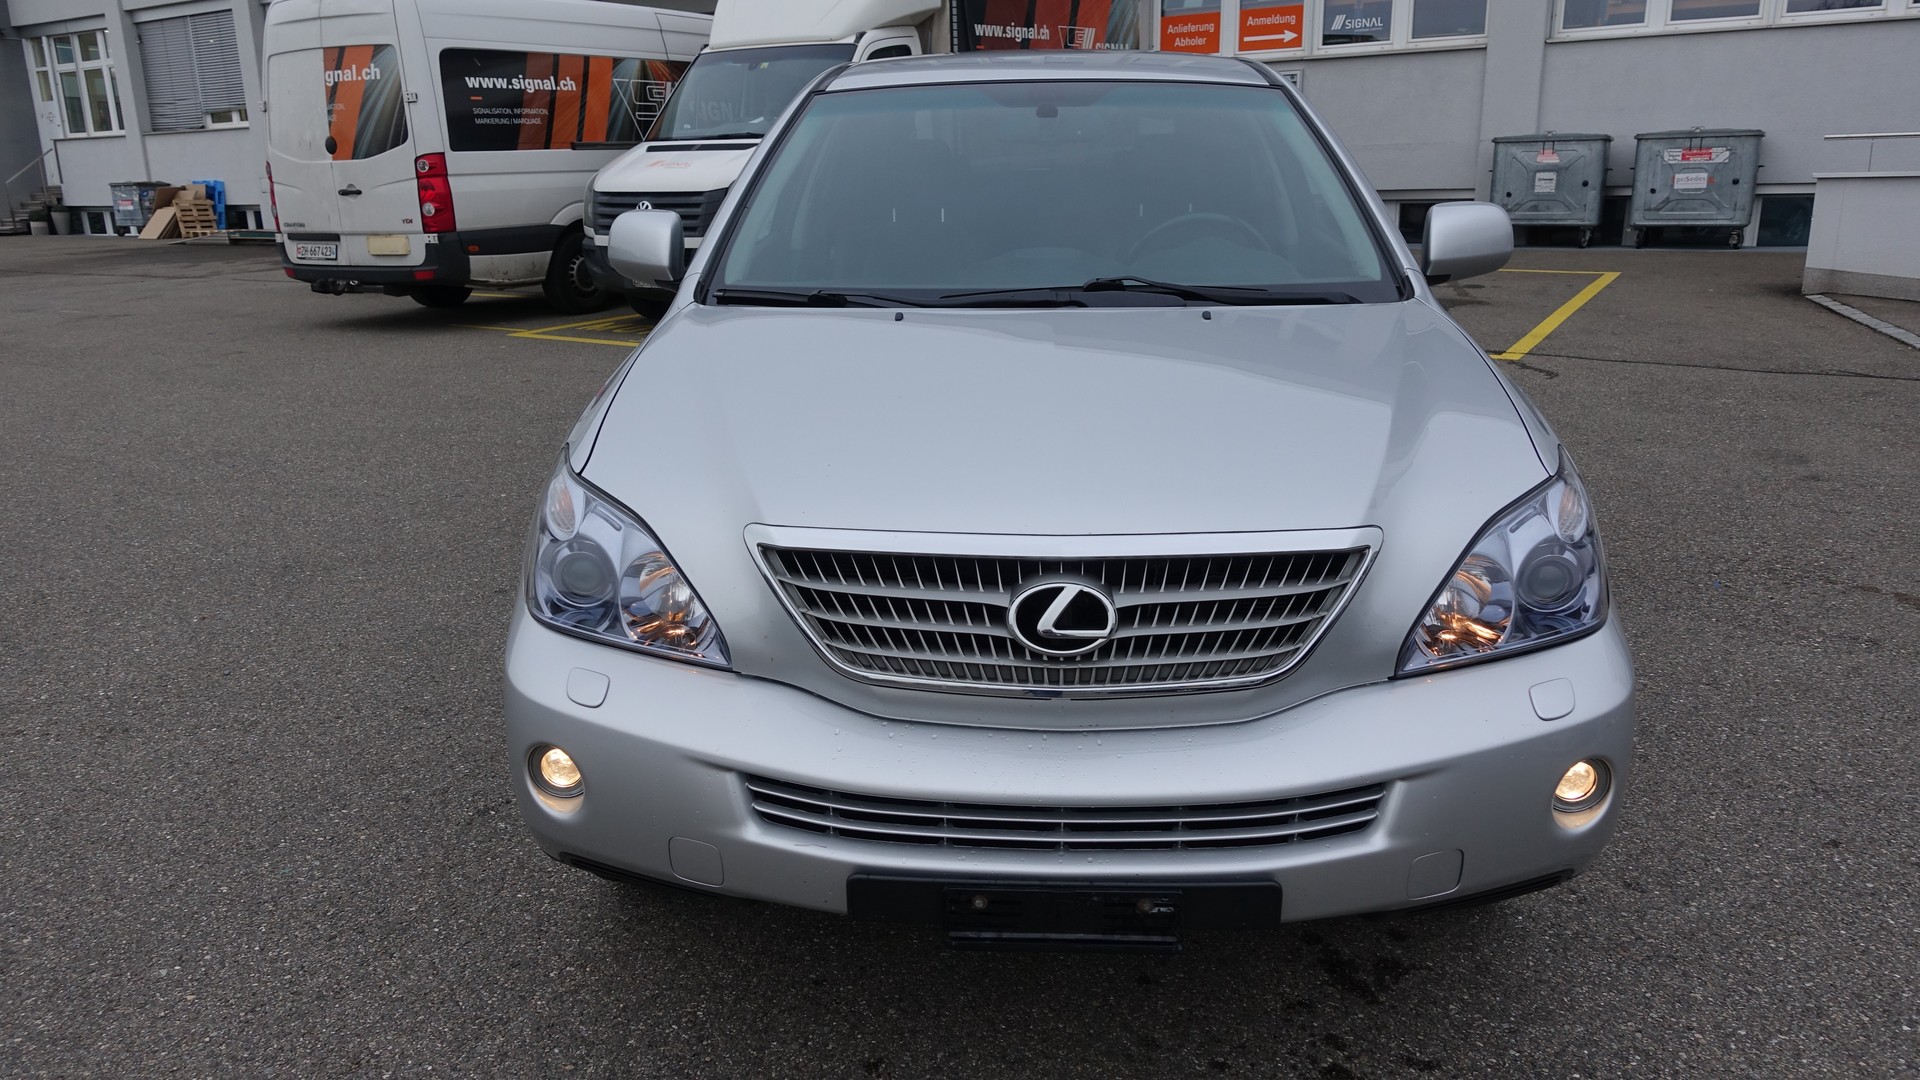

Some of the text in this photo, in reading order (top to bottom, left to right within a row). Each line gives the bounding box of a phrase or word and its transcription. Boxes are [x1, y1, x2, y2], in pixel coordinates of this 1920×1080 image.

[1247, 15, 1296, 26] Anmeldung
[1345, 17, 1383, 29] SIGNAL
[974, 22, 1050, 42] www.signal.ch
[1167, 23, 1214, 34] Anlieferung
[1174, 36, 1207, 47] Abholer
[325, 64, 381, 86] gnal.ch
[465, 75, 577, 93] www.signal.ch
